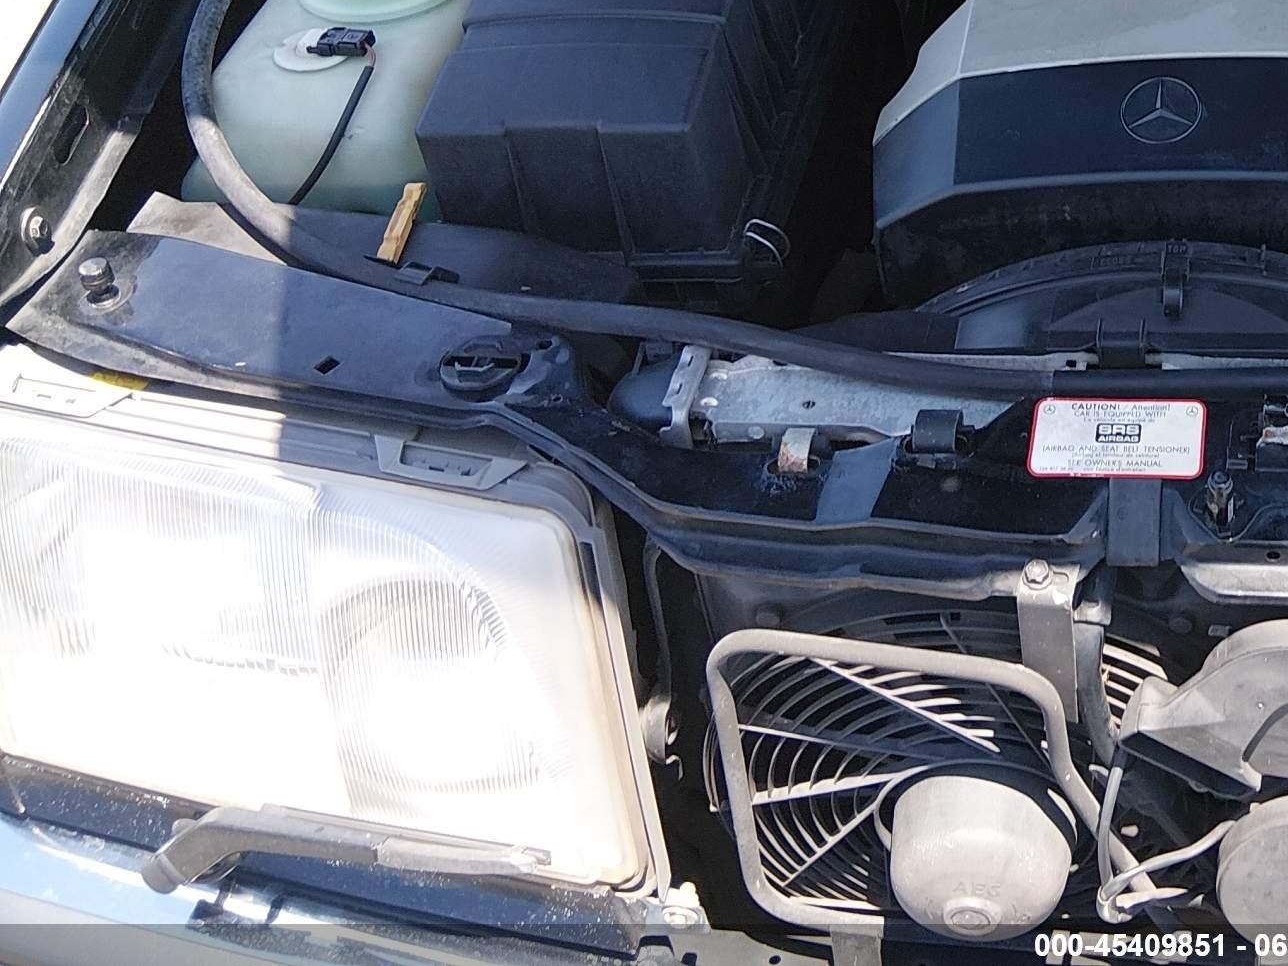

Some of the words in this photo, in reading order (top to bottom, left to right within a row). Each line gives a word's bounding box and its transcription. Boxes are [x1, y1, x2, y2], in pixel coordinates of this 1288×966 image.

[1071, 403, 1120, 411] CAUTION!
[1098, 424, 1140, 435] SRS
[1097, 434, 1139, 442] AIRBAG
[952, 881, 1001, 897] AEG
